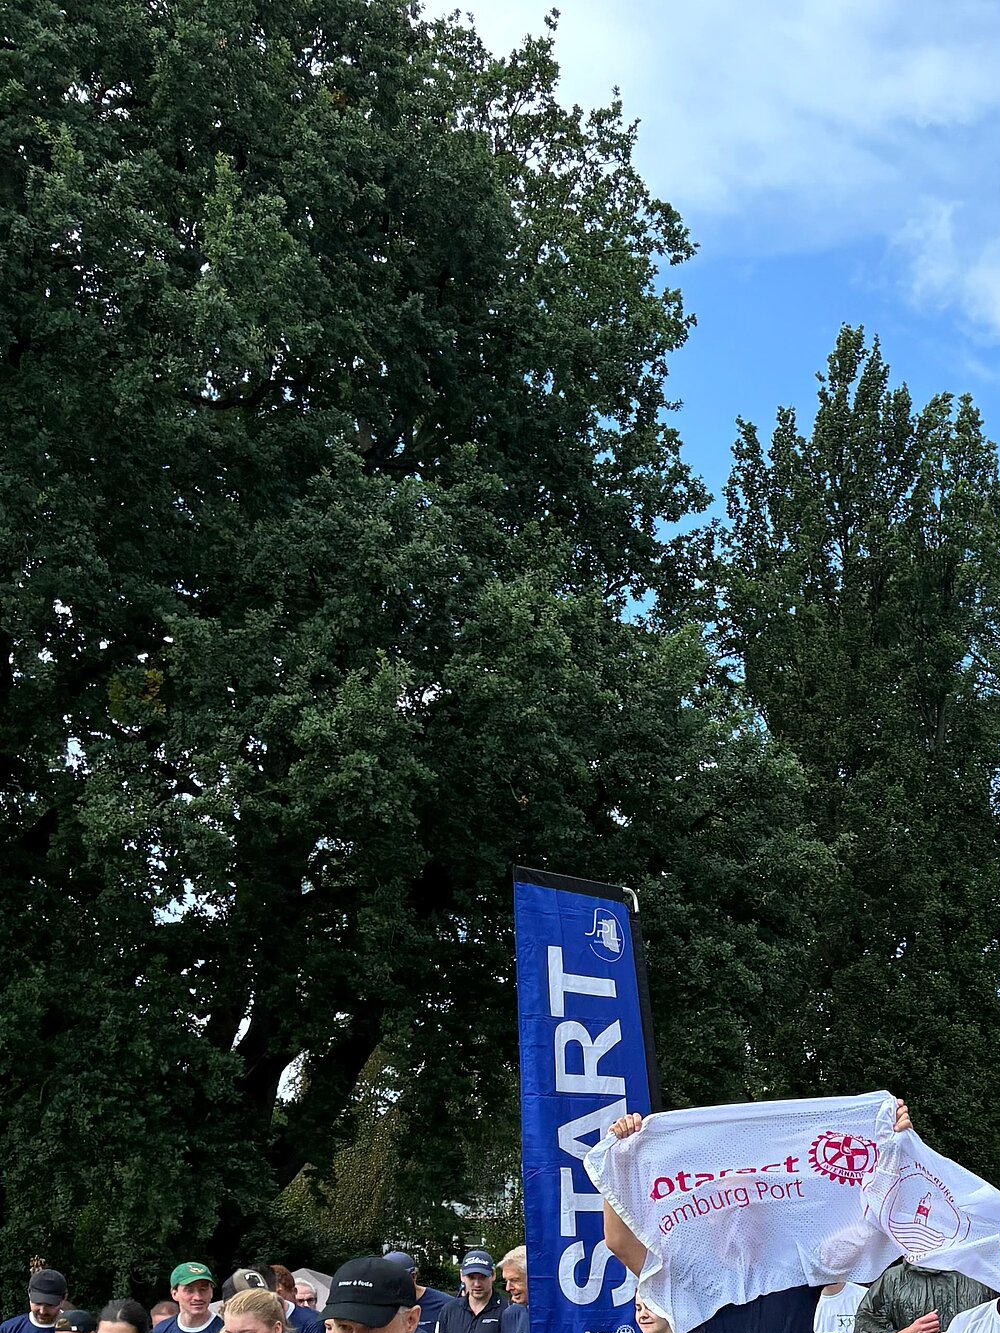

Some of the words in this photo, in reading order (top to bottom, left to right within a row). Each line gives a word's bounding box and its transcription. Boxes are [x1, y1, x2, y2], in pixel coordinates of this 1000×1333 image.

[548, 945, 639, 1307] START
[650, 1156, 799, 1200] otaract
[659, 1186, 750, 1235] amburg
[756, 1178, 805, 1200] Port
